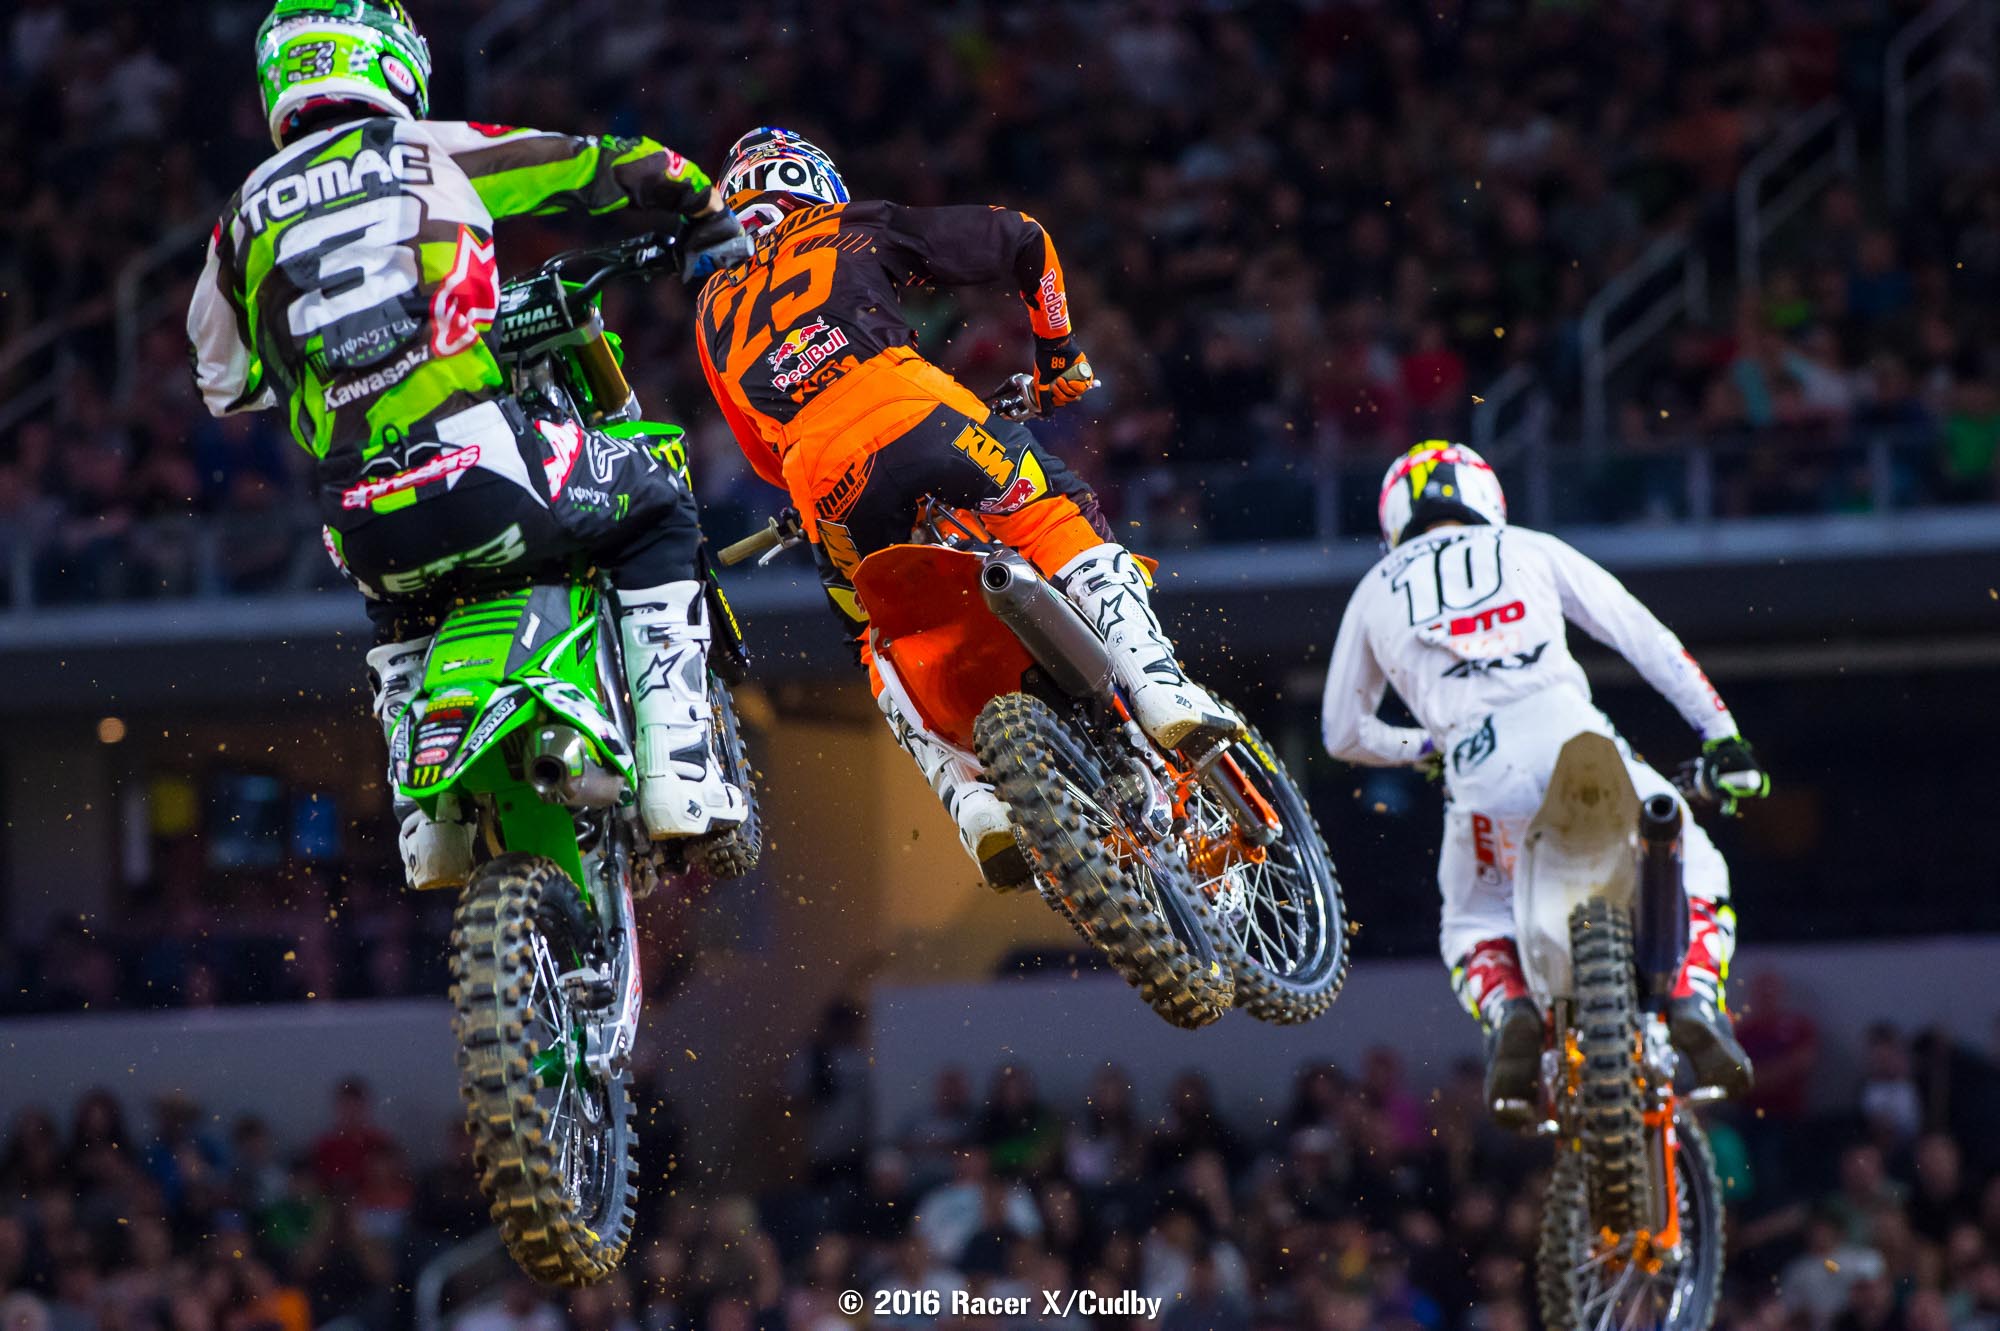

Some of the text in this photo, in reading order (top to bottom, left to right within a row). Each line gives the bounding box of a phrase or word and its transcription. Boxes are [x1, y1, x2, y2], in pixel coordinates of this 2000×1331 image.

[288, 40, 336, 83] 3
[388, 62, 410, 88] BELL
[240, 140, 433, 234] TOMAC
[274, 194, 423, 337] 3
[711, 216, 843, 380] 25
[324, 344, 430, 411] Kawasaki
[1051, 356, 1066, 369] 89
[951, 423, 1017, 490] KTM
[834, 477, 866, 516] RACING
[1391, 531, 1503, 627] 10
